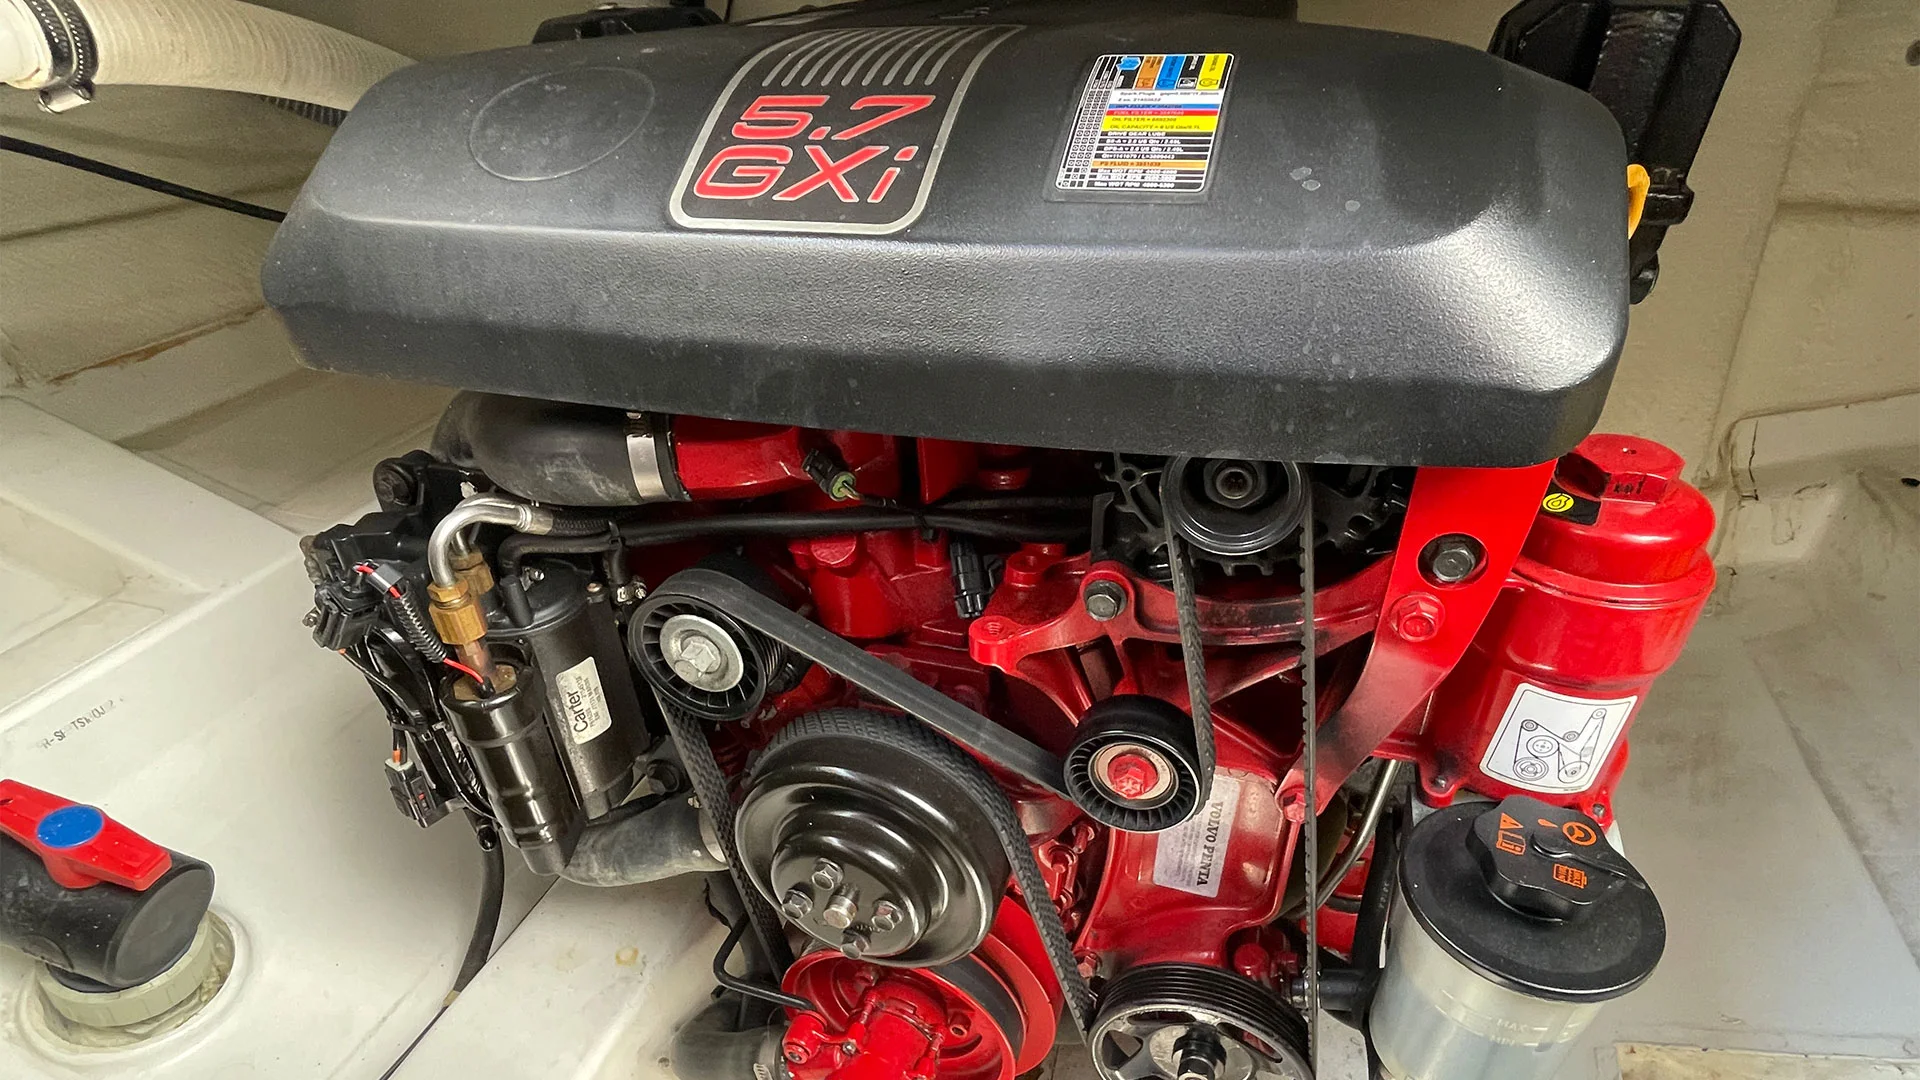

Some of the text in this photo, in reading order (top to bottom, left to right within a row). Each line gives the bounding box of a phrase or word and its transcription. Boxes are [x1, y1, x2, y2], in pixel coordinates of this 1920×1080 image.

[731, 94, 936, 140] 5.7
[693, 144, 919, 203] GXi
[566, 690, 588, 733] Carter
[1196, 801, 1224, 886] VOLVO PENTA
[1496, 1018, 1528, 1032] MAX
